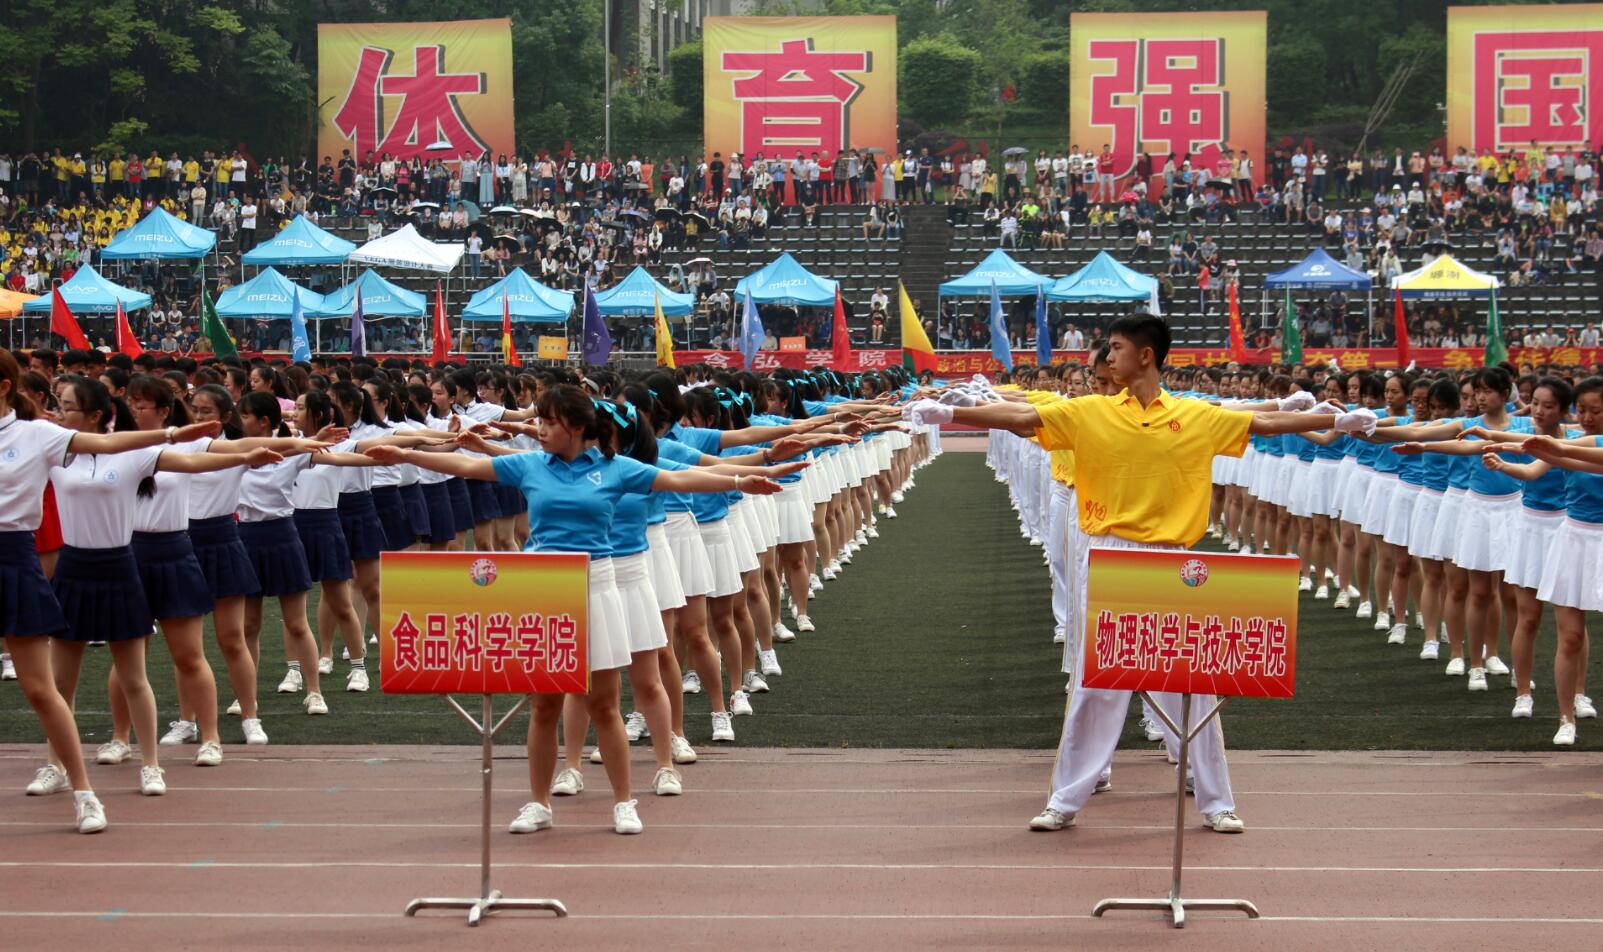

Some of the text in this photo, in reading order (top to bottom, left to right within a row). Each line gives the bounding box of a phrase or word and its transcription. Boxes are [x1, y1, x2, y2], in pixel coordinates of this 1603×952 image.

[334, 44, 490, 163] 体
[721, 38, 871, 168] 育
[1089, 38, 1230, 180] 强
[1473, 29, 1603, 164] 国
[361, 295, 391, 305] EIZU
[391, 611, 579, 674] 食品科学学院
[1095, 609, 1288, 678] 物理科学与技术学院
